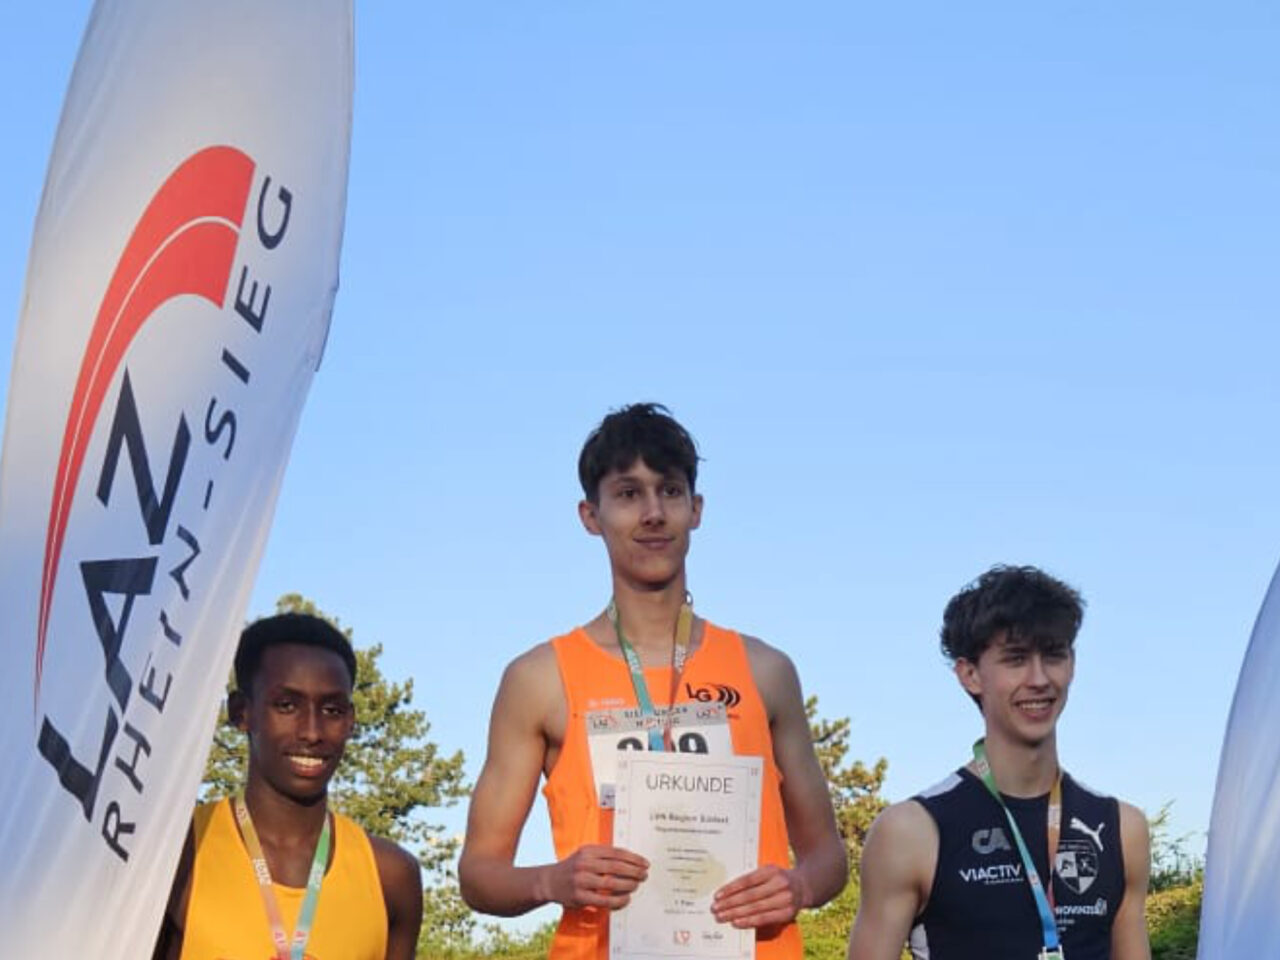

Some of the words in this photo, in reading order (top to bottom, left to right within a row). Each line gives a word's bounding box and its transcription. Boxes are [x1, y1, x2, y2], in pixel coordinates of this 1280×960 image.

[102, 175, 293, 863] RHEIN-SIEG
[37, 365, 192, 823] LAZ
[686, 682, 712, 703] LG
[646, 774, 734, 794] URKUNDE
[958, 864, 1022, 883] VIACTIV
